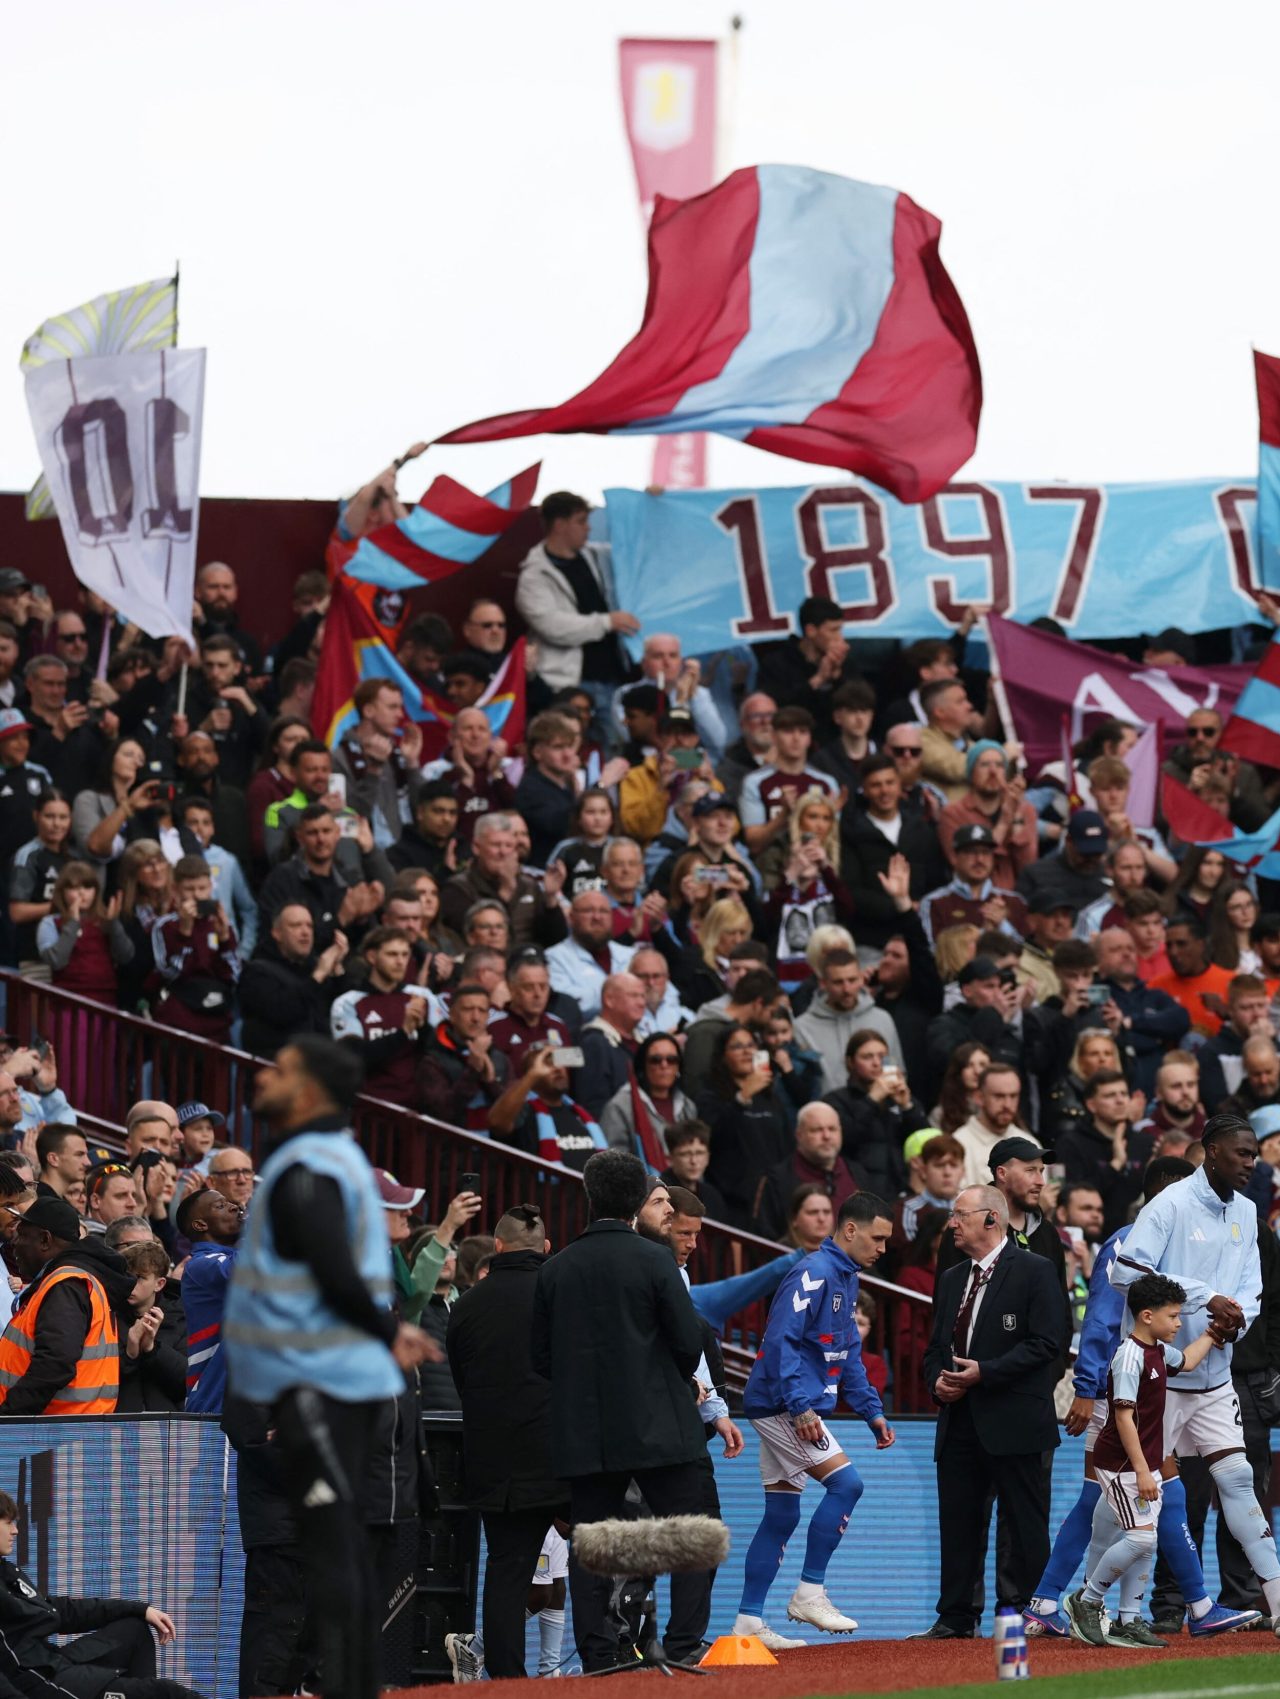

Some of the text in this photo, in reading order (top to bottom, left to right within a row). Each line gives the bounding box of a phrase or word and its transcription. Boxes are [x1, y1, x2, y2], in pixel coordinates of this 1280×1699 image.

[712, 481, 1107, 639] 1897
[1181, 1523, 1197, 1551] SAFC
[387, 1572, 414, 1610] adi.tv
